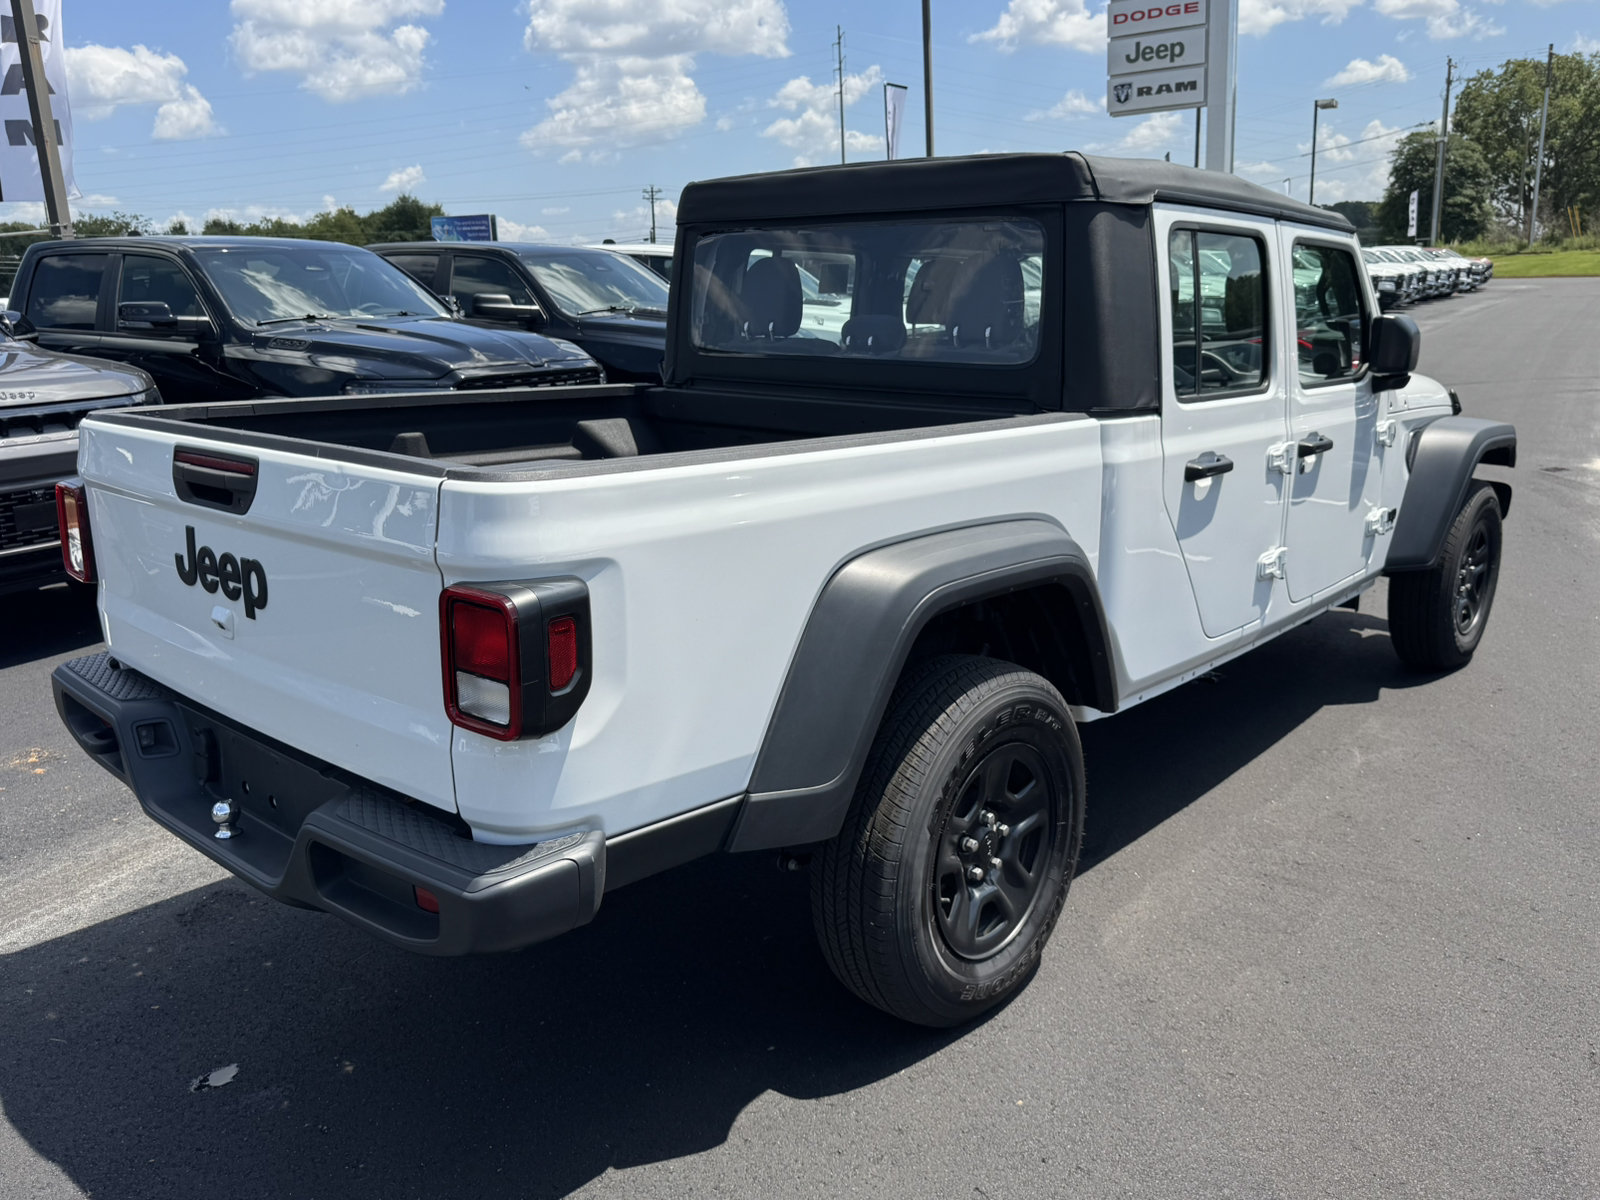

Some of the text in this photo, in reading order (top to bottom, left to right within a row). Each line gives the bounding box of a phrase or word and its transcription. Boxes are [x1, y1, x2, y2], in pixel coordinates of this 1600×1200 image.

[1113, 2, 1199, 24] DODGE
[1125, 41, 1185, 64] Jeep
[1136, 80, 1197, 97] RAM
[175, 525, 268, 620] Jeep
